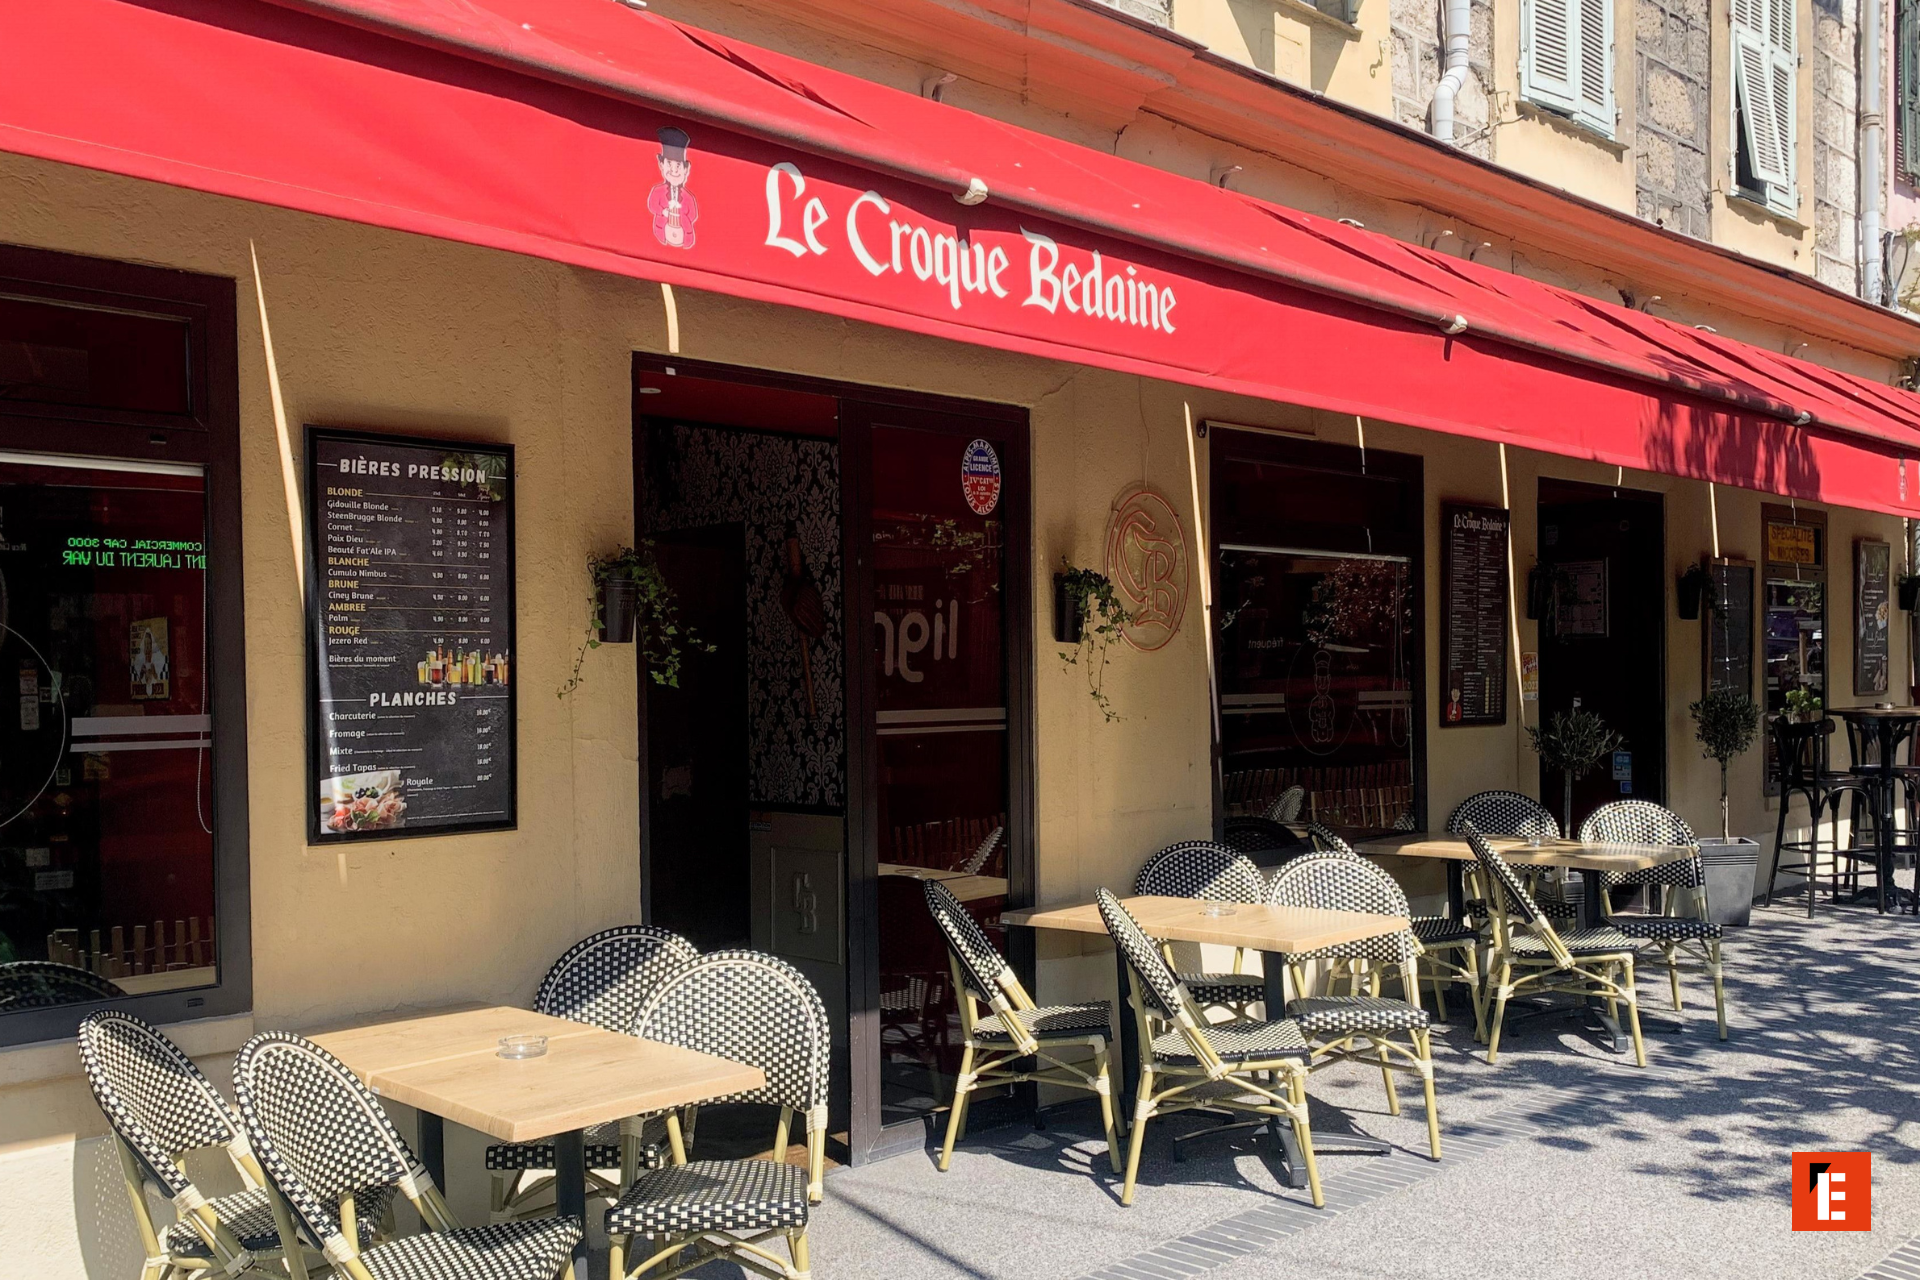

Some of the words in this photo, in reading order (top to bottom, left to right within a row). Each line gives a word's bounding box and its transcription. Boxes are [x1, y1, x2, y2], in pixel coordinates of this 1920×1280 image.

[764, 162, 829, 257] Le
[846, 190, 1011, 310] Croque
[1019, 225, 1177, 333] Bedaine
[340, 456, 400, 476] BIÈRES
[408, 465, 486, 483] PRESSION
[970, 463, 992, 472] LICENCE
[327, 487, 363, 497] BLONDE
[964, 480, 976, 506] TOUS
[977, 483, 999, 514] ALCOOLS
[327, 500, 361, 509] Gidouille
[363, 502, 389, 511] Blonde
[327, 511, 375, 523] SteenBrugge
[377, 514, 403, 523] Blonde
[327, 523, 353, 531] Cornet
[1453, 513, 1461, 528] Le
[1462, 514, 1481, 532] Croque
[1481, 516, 1503, 532] Bedaine
[327, 535, 345, 543] Paix
[346, 535, 364, 543] Dieu
[327, 545, 354, 554] Beauté
[384, 548, 397, 556] IPA
[328, 557, 369, 566] BLANCHE
[328, 568, 357, 577] Cumulo
[359, 570, 387, 578] Nimbus
[328, 580, 359, 589] BRUNE
[328, 591, 350, 600] Ciney
[351, 591, 374, 600] Brune
[328, 603, 366, 612] AMBREE
[328, 614, 349, 622] Palm
[329, 626, 360, 636] ROUGE
[329, 637, 352, 646] Jezero
[354, 637, 368, 645] Red
[329, 654, 352, 663] Bières
[354, 655, 364, 663] du
[369, 692, 457, 707] PLANCHES
[329, 711, 376, 721] Charcuterie
[329, 729, 365, 739] Fromage
[329, 747, 353, 755] Mixte
[329, 765, 350, 773] Fried
[353, 764, 377, 772] Tapas
[406, 777, 433, 787] Royale
